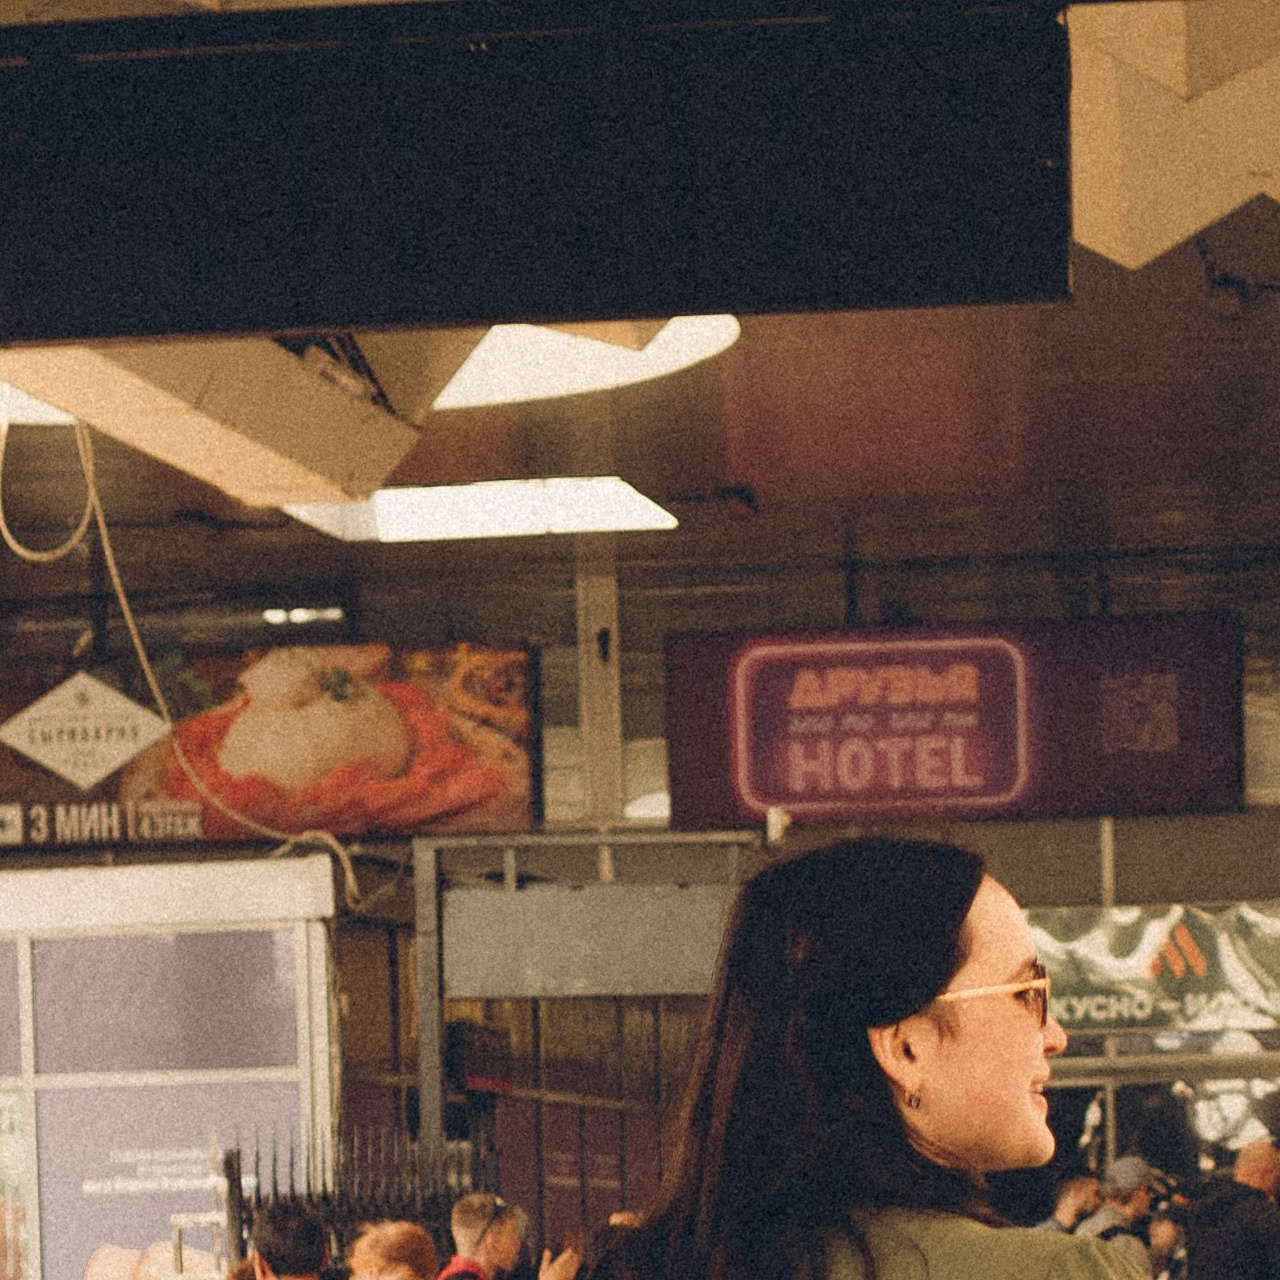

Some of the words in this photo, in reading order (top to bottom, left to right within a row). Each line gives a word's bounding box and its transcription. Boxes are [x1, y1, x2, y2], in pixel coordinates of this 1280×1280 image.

[788, 734, 984, 792] HOTEL
[29, 805, 49, 844] 3
[55, 802, 120, 842] МИН
[1050, 994, 1153, 1020] КУСНО
